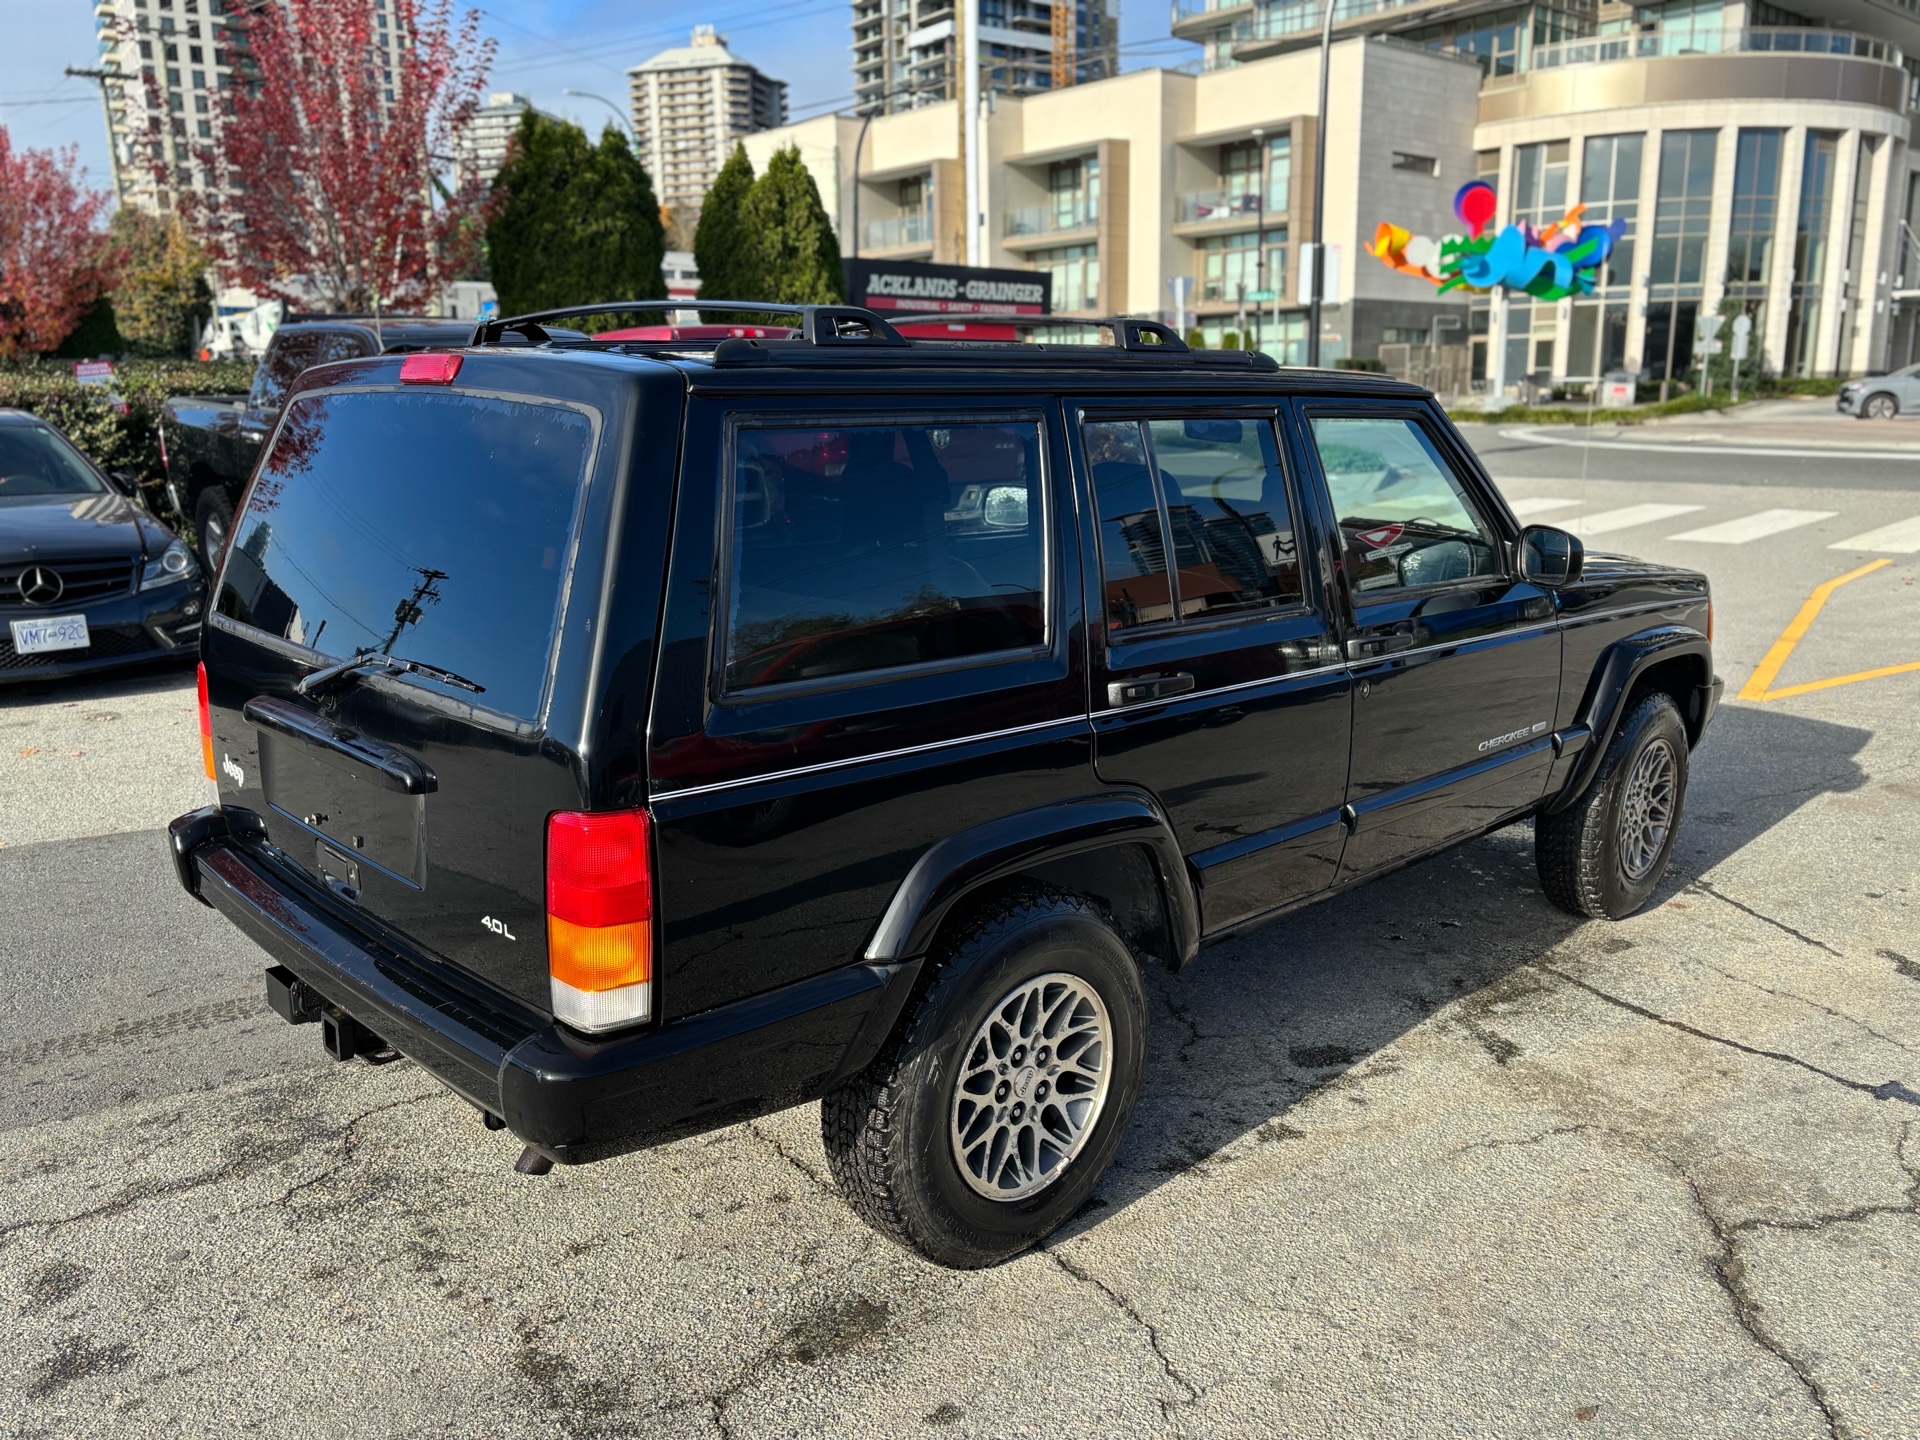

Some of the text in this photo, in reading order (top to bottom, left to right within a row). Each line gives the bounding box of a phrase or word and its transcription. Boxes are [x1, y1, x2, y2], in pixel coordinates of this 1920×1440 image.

[895, 300, 1017, 314] INDUSTRIAL SAFETY FASTENERS
[1479, 727, 1530, 751] CHEROKEE
[222, 753, 244, 788] Jeep
[1020, 1070, 1034, 1096] Jeep
